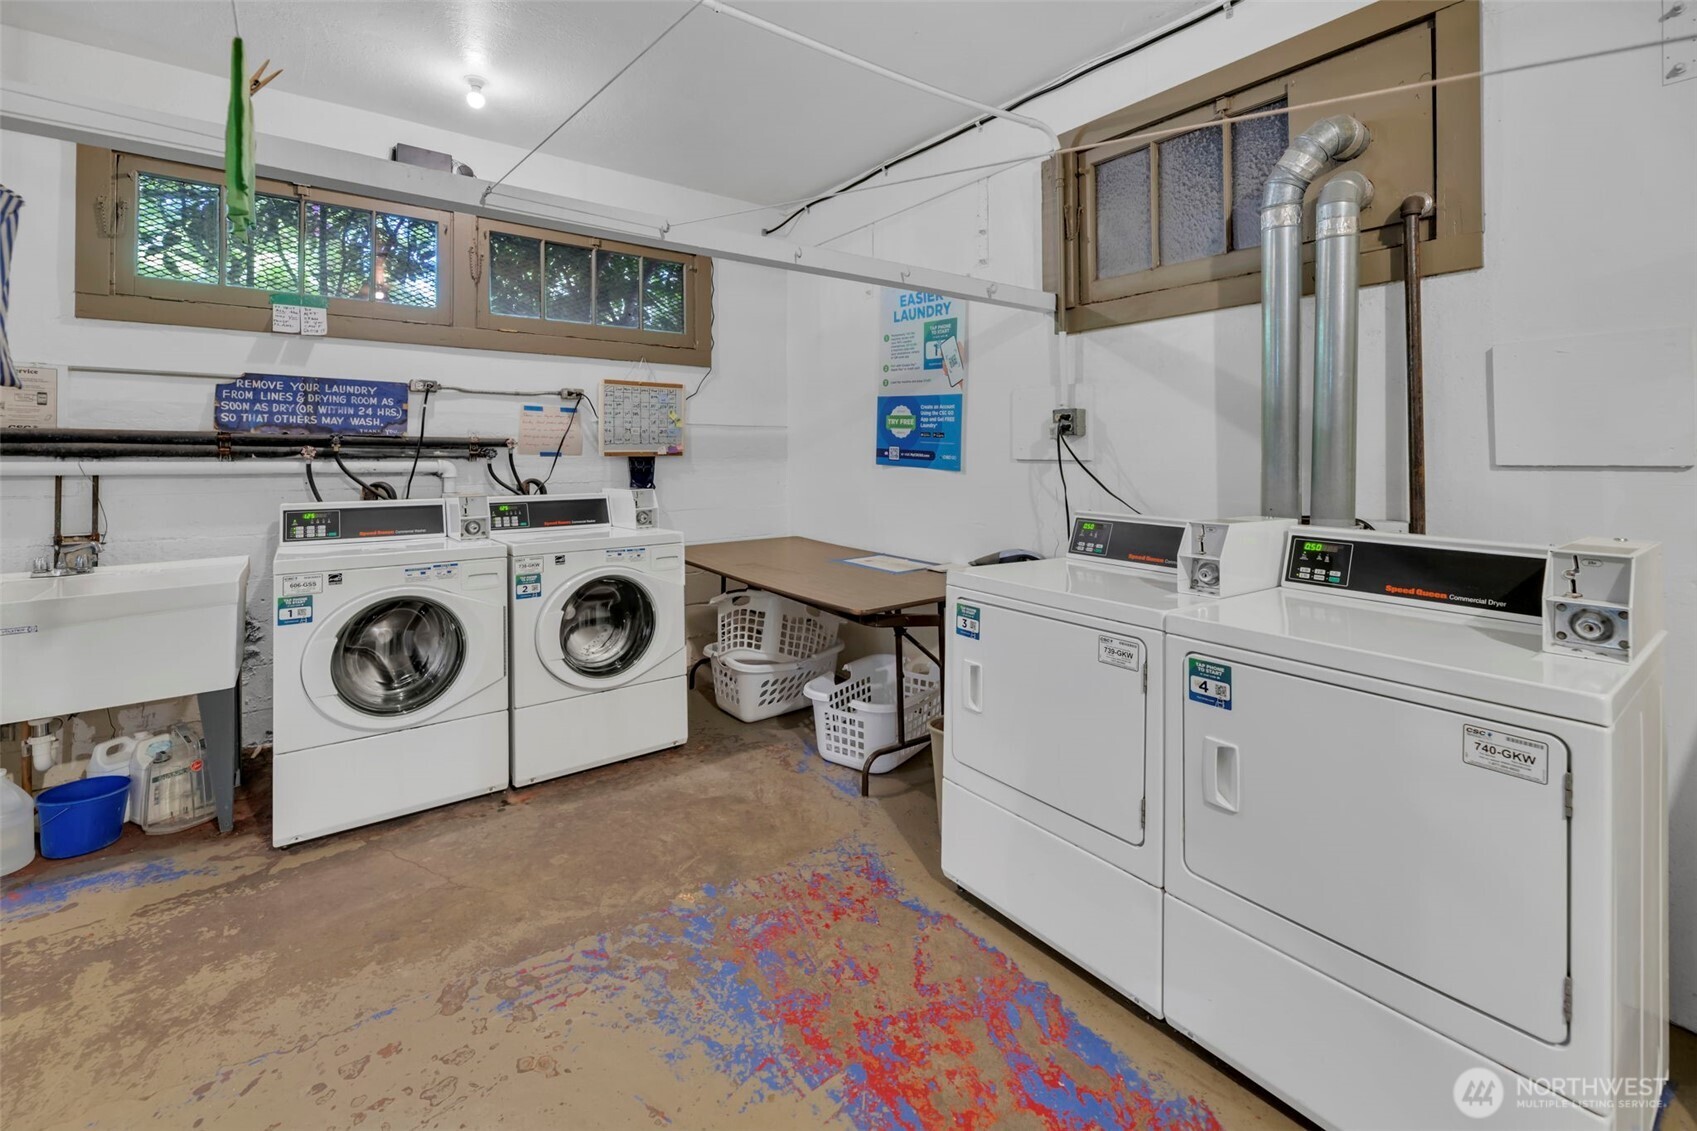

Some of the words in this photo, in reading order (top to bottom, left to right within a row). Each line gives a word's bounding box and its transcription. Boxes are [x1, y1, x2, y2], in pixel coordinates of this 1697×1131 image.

[900, 292, 944, 307] EASIER
[894, 302, 951, 322] LAUNDRY
[237, 379, 283, 390] REMOVE
[290, 382, 320, 392] YOUR
[326, 384, 377, 395] LAUNDRY
[223, 390, 253, 399] FROM
[296, 393, 305, 403] &
[308, 395, 346, 403] DRYING
[351, 397, 377, 405] ROOM
[221, 401, 249, 410] SOON
[318, 405, 354, 414] WITHIN
[358, 407, 373, 415] 24
[378, 406, 402, 419] HRS.)
[221, 413, 236, 422] SO
[241, 414, 268, 422] THAT
[274, 415, 317, 424] OTHERS
[350, 418, 383, 426] WASH.
[1386, 584, 1415, 594] Speed
[1416, 589, 1447, 599] Queen
[1449, 594, 1486, 604] Commercial
[1488, 599, 1506, 607] Dryer
[962, 618, 967, 628] 3
[1104, 647, 1133, 659] 739-GKW
[1199, 681, 1208, 693] 4
[1466, 727, 1486, 736] CSC
[1474, 742, 1536, 765] 740-GKW
